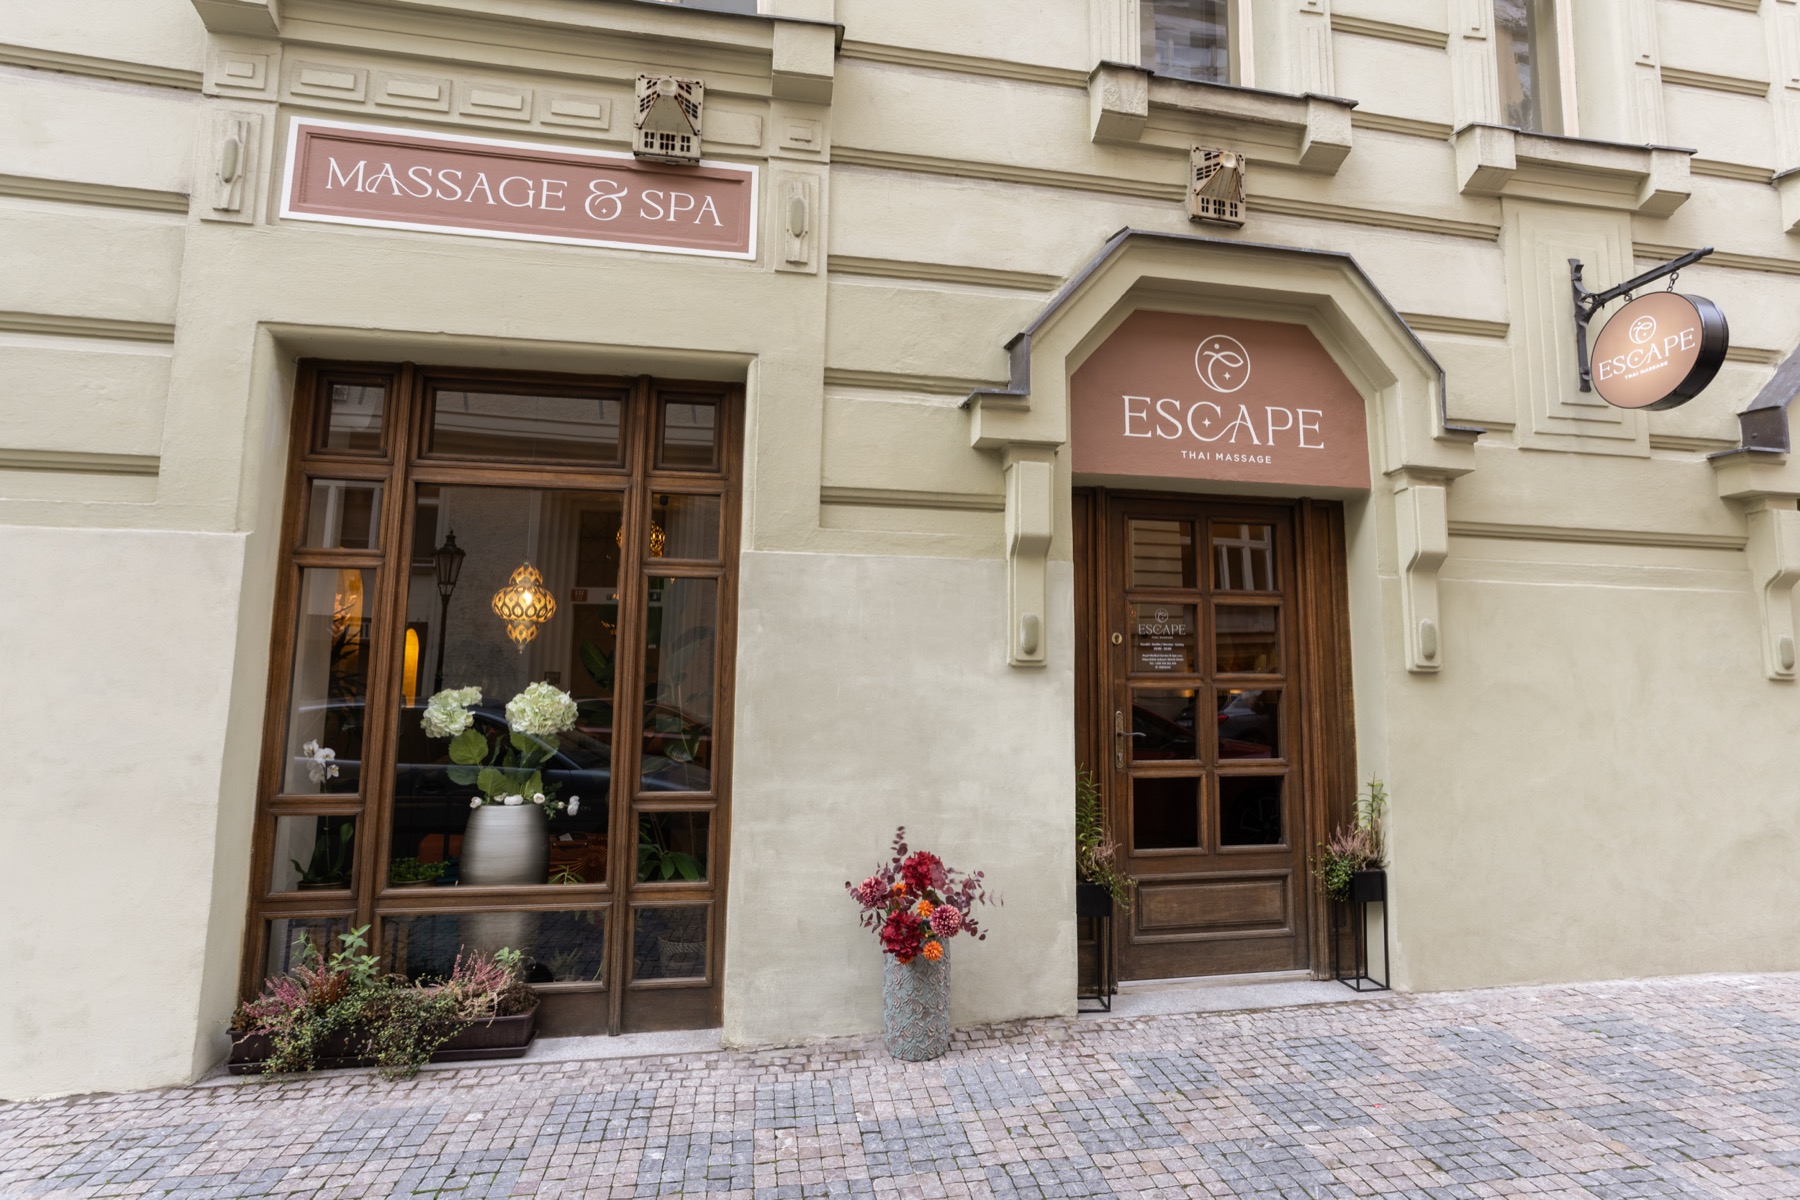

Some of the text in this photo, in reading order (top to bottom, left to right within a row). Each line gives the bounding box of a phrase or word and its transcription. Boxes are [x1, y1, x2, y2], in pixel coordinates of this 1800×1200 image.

[325, 157, 723, 227] MASSAGE & SPA
[1598, 328, 1695, 380] ESCAPE
[1624, 361, 1669, 380] THAI MASSAGE
[1122, 395, 1325, 449] ESCAPE
[1181, 450, 1272, 464] THAI MASSAGE
[1138, 624, 1186, 635] ESCAPE
